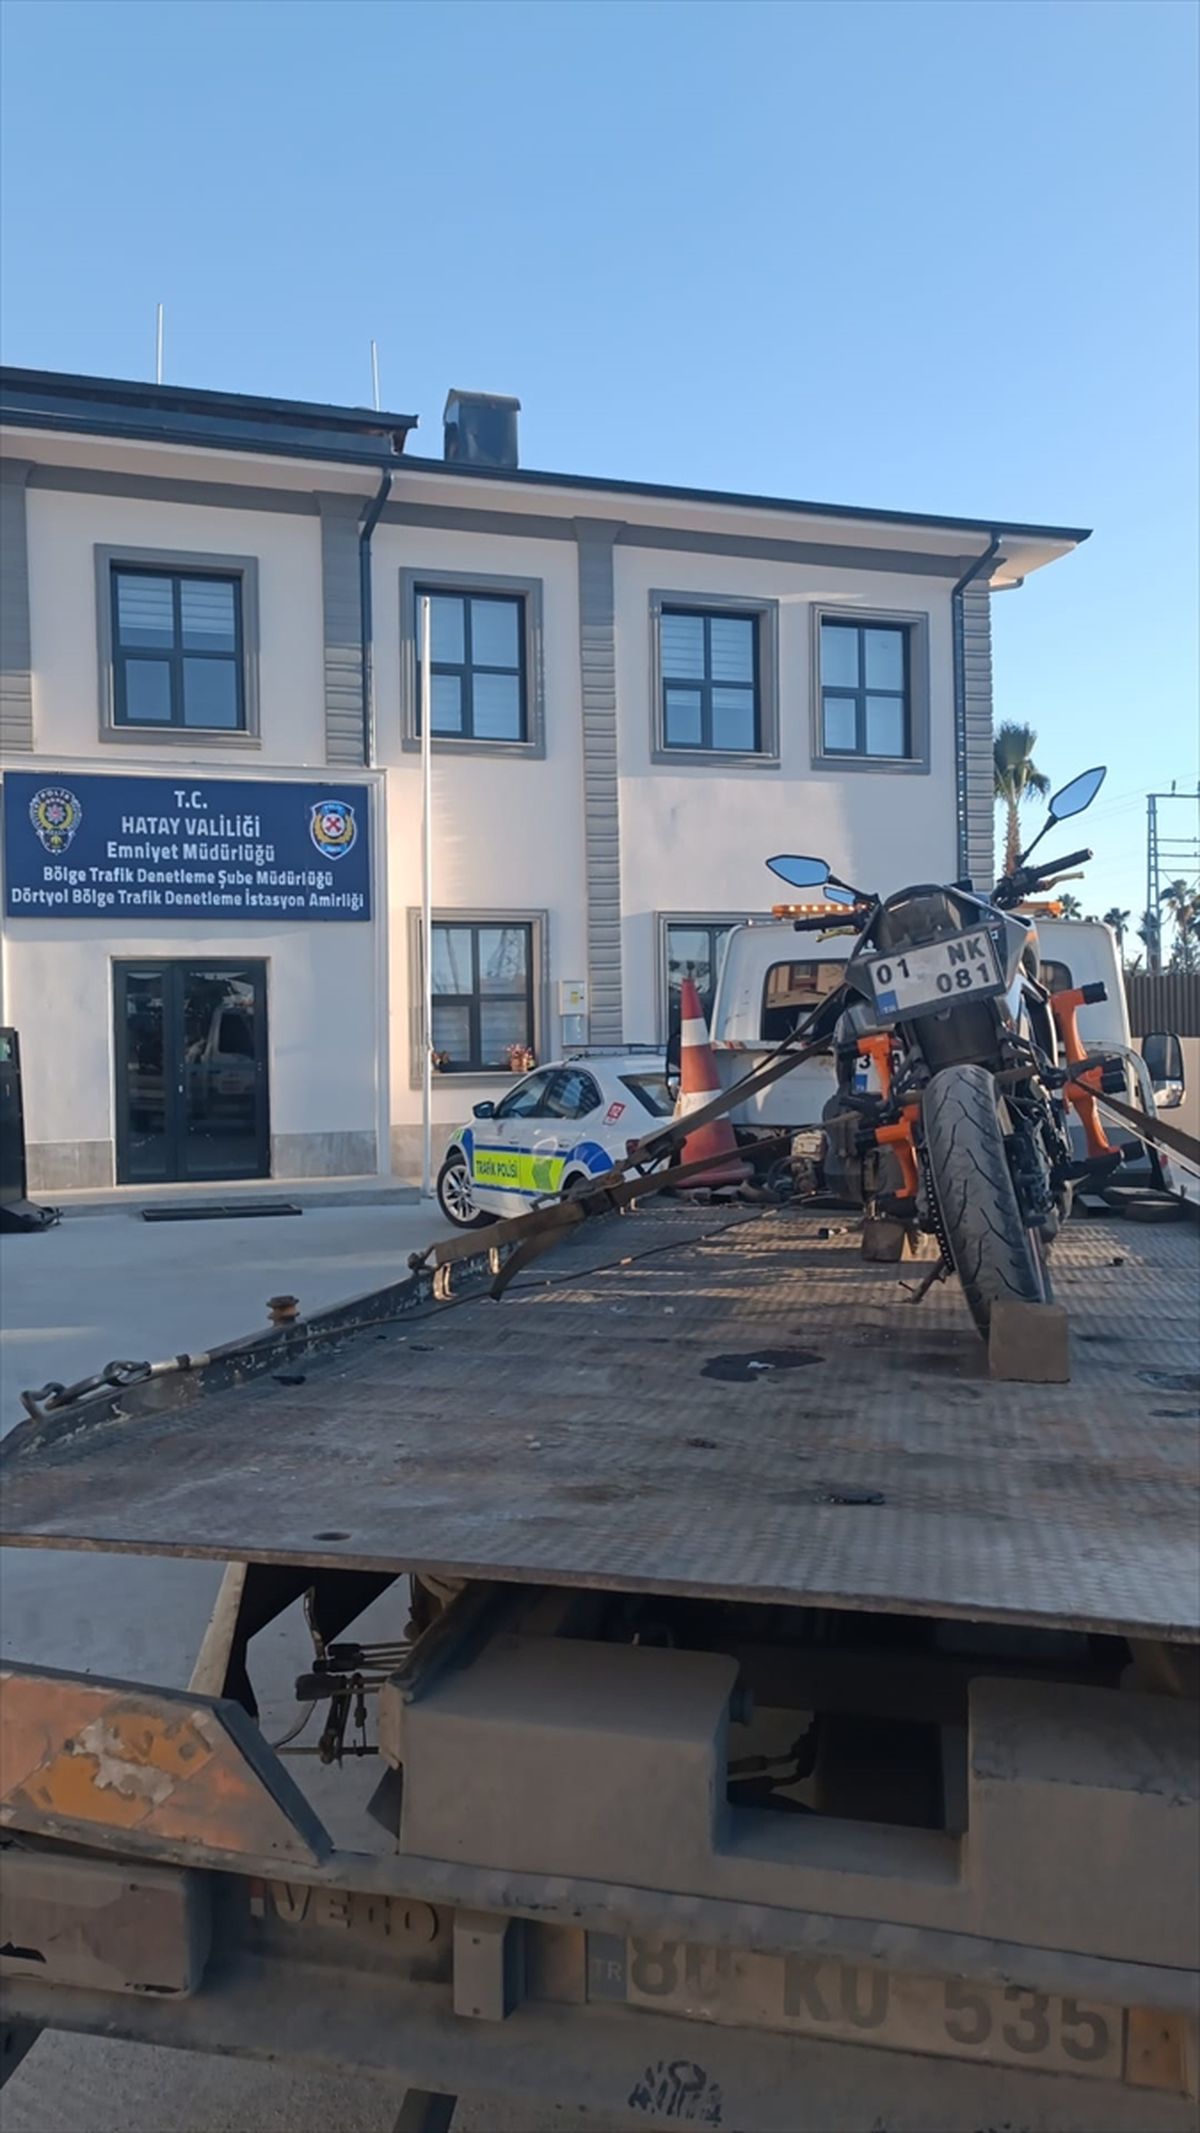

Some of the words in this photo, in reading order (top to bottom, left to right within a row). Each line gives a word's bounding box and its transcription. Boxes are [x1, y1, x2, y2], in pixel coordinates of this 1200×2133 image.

[174, 790, 208, 809] T.C.
[122, 816, 180, 835] HATAY
[185, 814, 260, 838] VALİLİĞİ
[107, 841, 178, 863] Emniyet
[183, 842, 275, 866] Müdürlüğü
[43, 866, 86, 886] Bölge
[89, 867, 134, 882] Trafik
[137, 868, 215, 884] Denetleme
[218, 870, 253, 889] Şube
[256, 870, 333, 890] Müdürlüğü
[11, 888, 68, 906] Dörtyol
[72, 888, 115, 908] Bölge
[117, 889, 162, 904] Trafik
[165, 890, 242, 906] Denetleme
[245, 889, 305, 909] İstasyon
[309, 893, 364, 911] Amirliği
[946, 937, 986, 966] NK
[876, 958, 910, 985] 01
[936, 963, 990, 993] 081
[249, 1879, 441, 1944] IVECO
[593, 1958, 623, 1982] TR
[783, 1952, 890, 2029] KU
[944, 1980, 1109, 2063] 535
